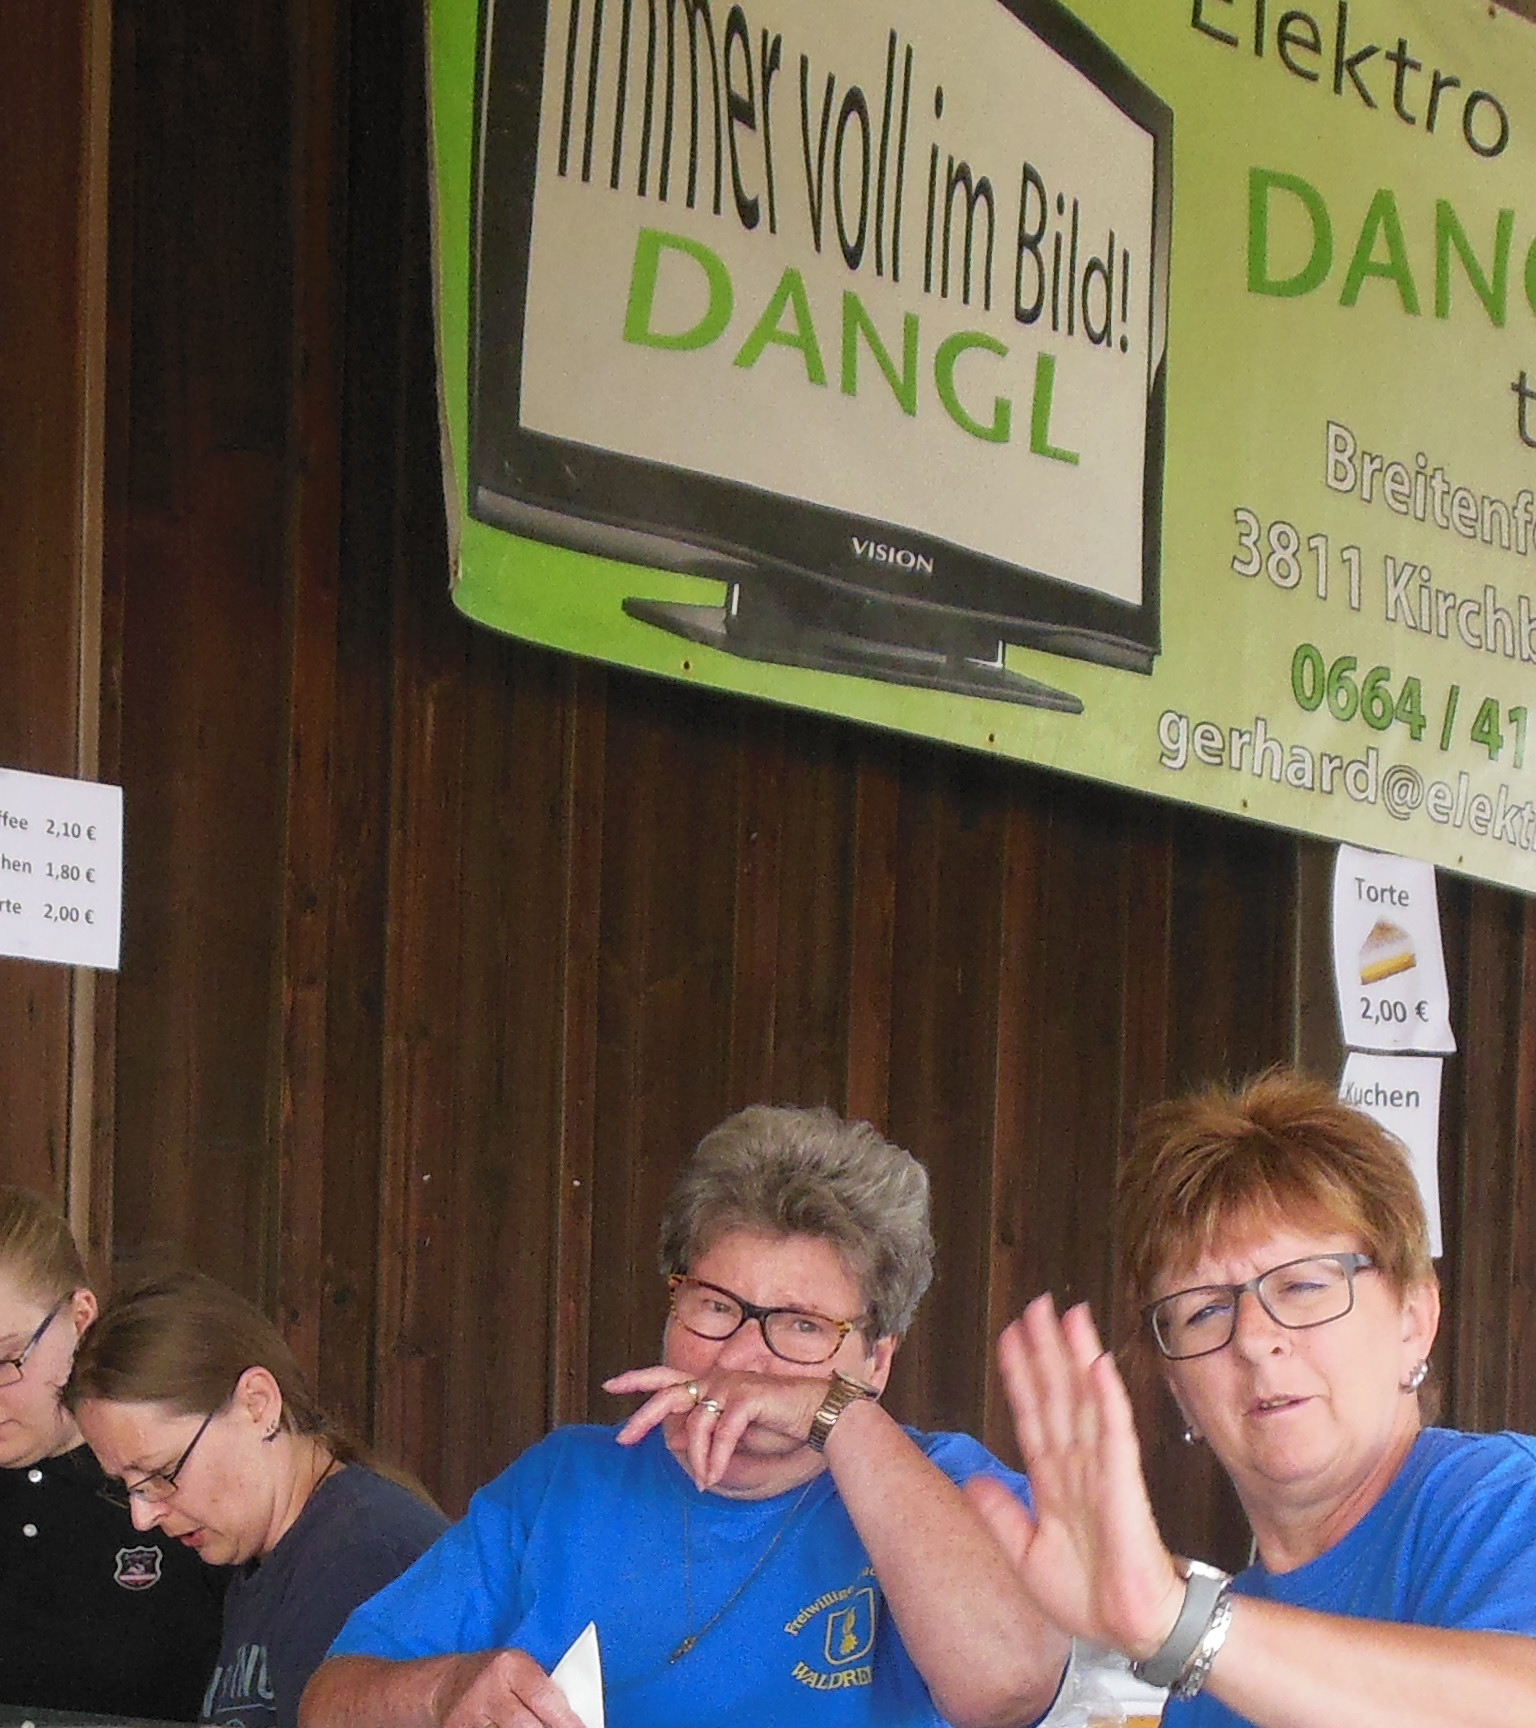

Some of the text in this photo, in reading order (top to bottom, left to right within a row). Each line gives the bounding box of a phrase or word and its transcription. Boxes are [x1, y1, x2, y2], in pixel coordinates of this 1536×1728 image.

[800, 29, 913, 283] voll
[924, 86, 993, 311] im
[1014, 163, 1131, 353] Bild!
[622, 226, 1080, 466] DANGL
[851, 536, 934, 575] VISION
[1230, 508, 1363, 612] 3811
[1290, 642, 1426, 742] 0664
[1440, 684, 1460, 752] /
[1470, 694, 1528, 770] 41
[46, 819, 81, 839] 2,10
[46, 862, 80, 881] 1,80
[1354, 877, 1409, 907] Torte
[43, 904, 79, 923] 2,00
[1361, 997, 1407, 1024] 2,00
